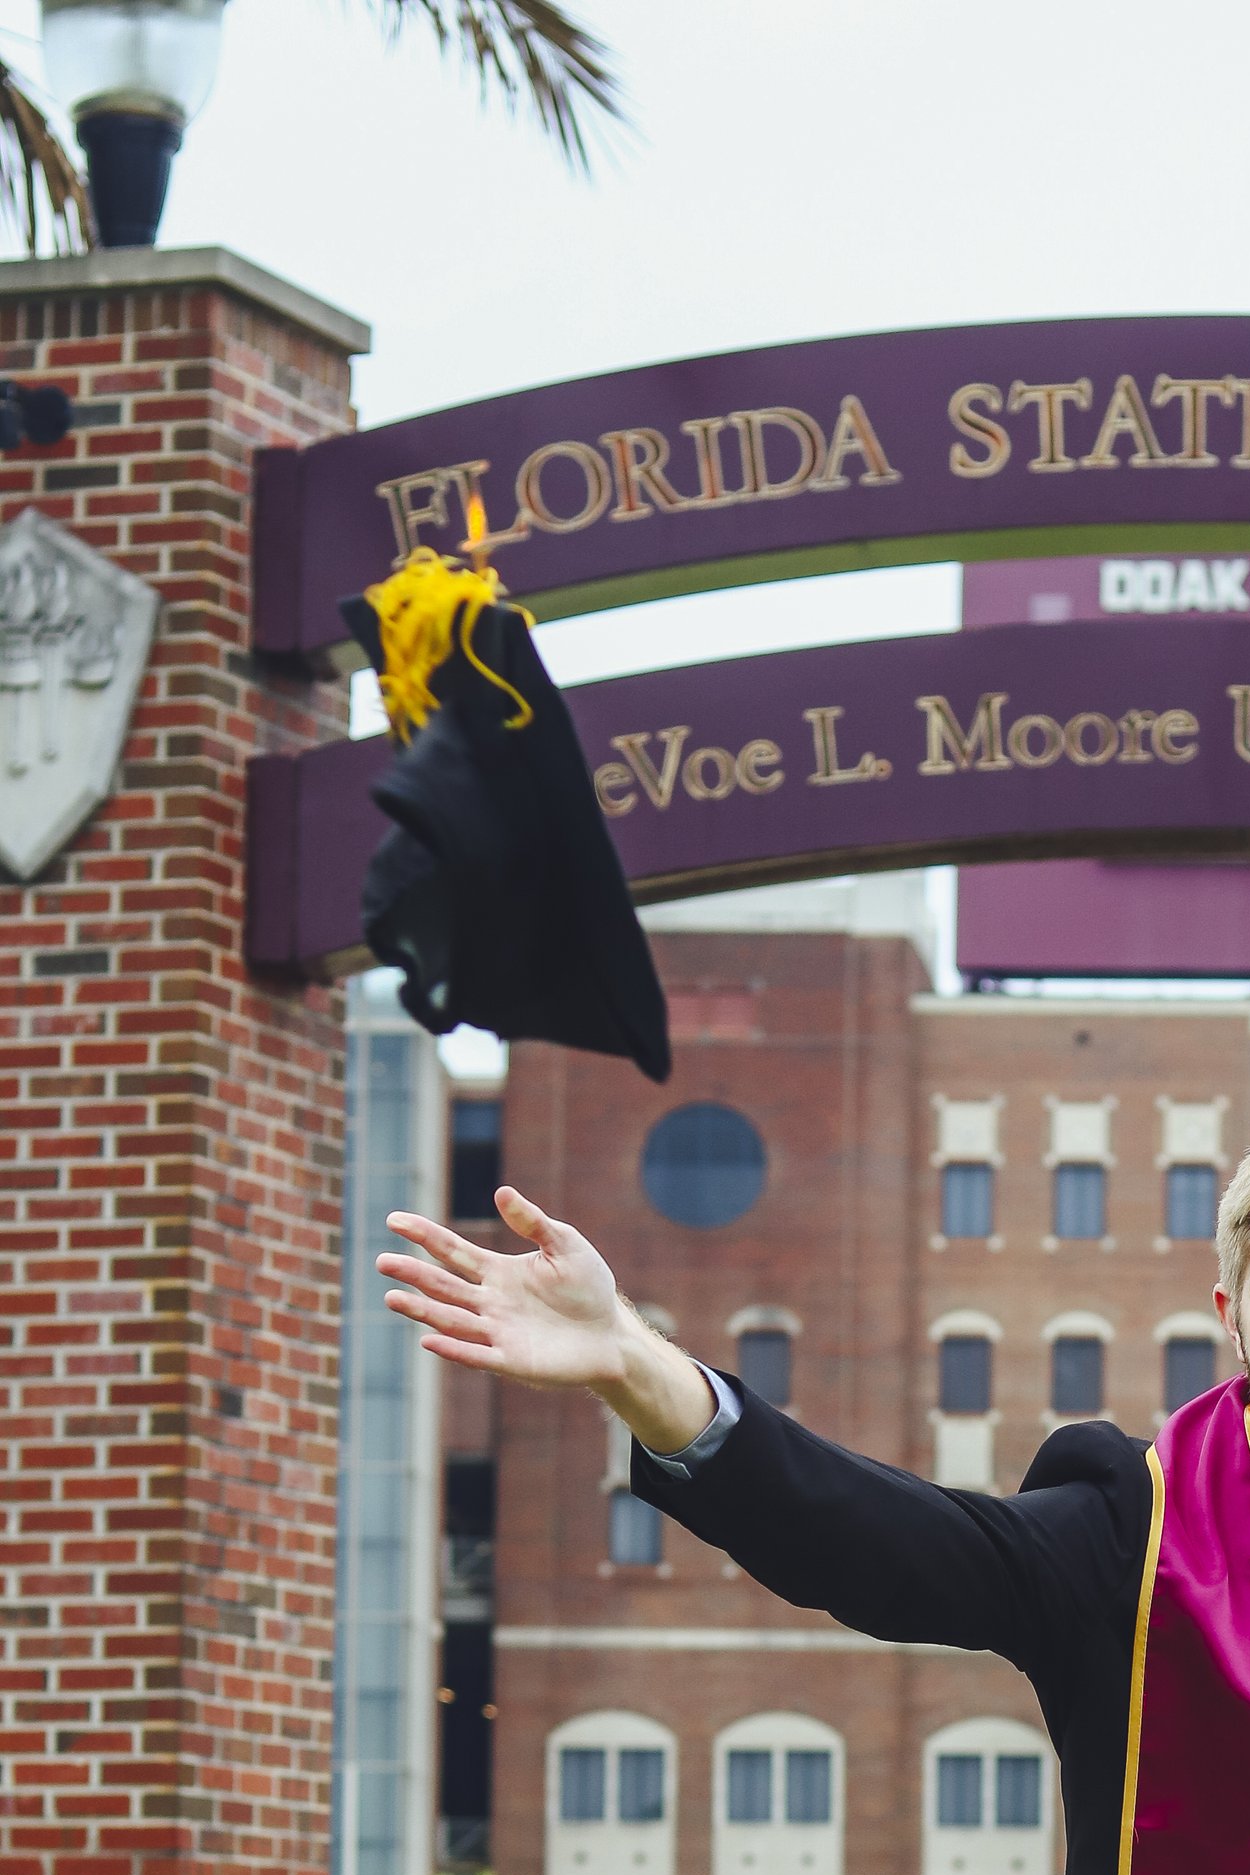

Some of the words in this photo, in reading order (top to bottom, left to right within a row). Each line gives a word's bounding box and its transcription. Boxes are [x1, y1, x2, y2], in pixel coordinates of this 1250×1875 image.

[375, 394, 903, 570] FLORIDA
[593, 724, 787, 818] eVoe
[802, 705, 894, 787] L.
[916, 691, 1201, 775] Moore
